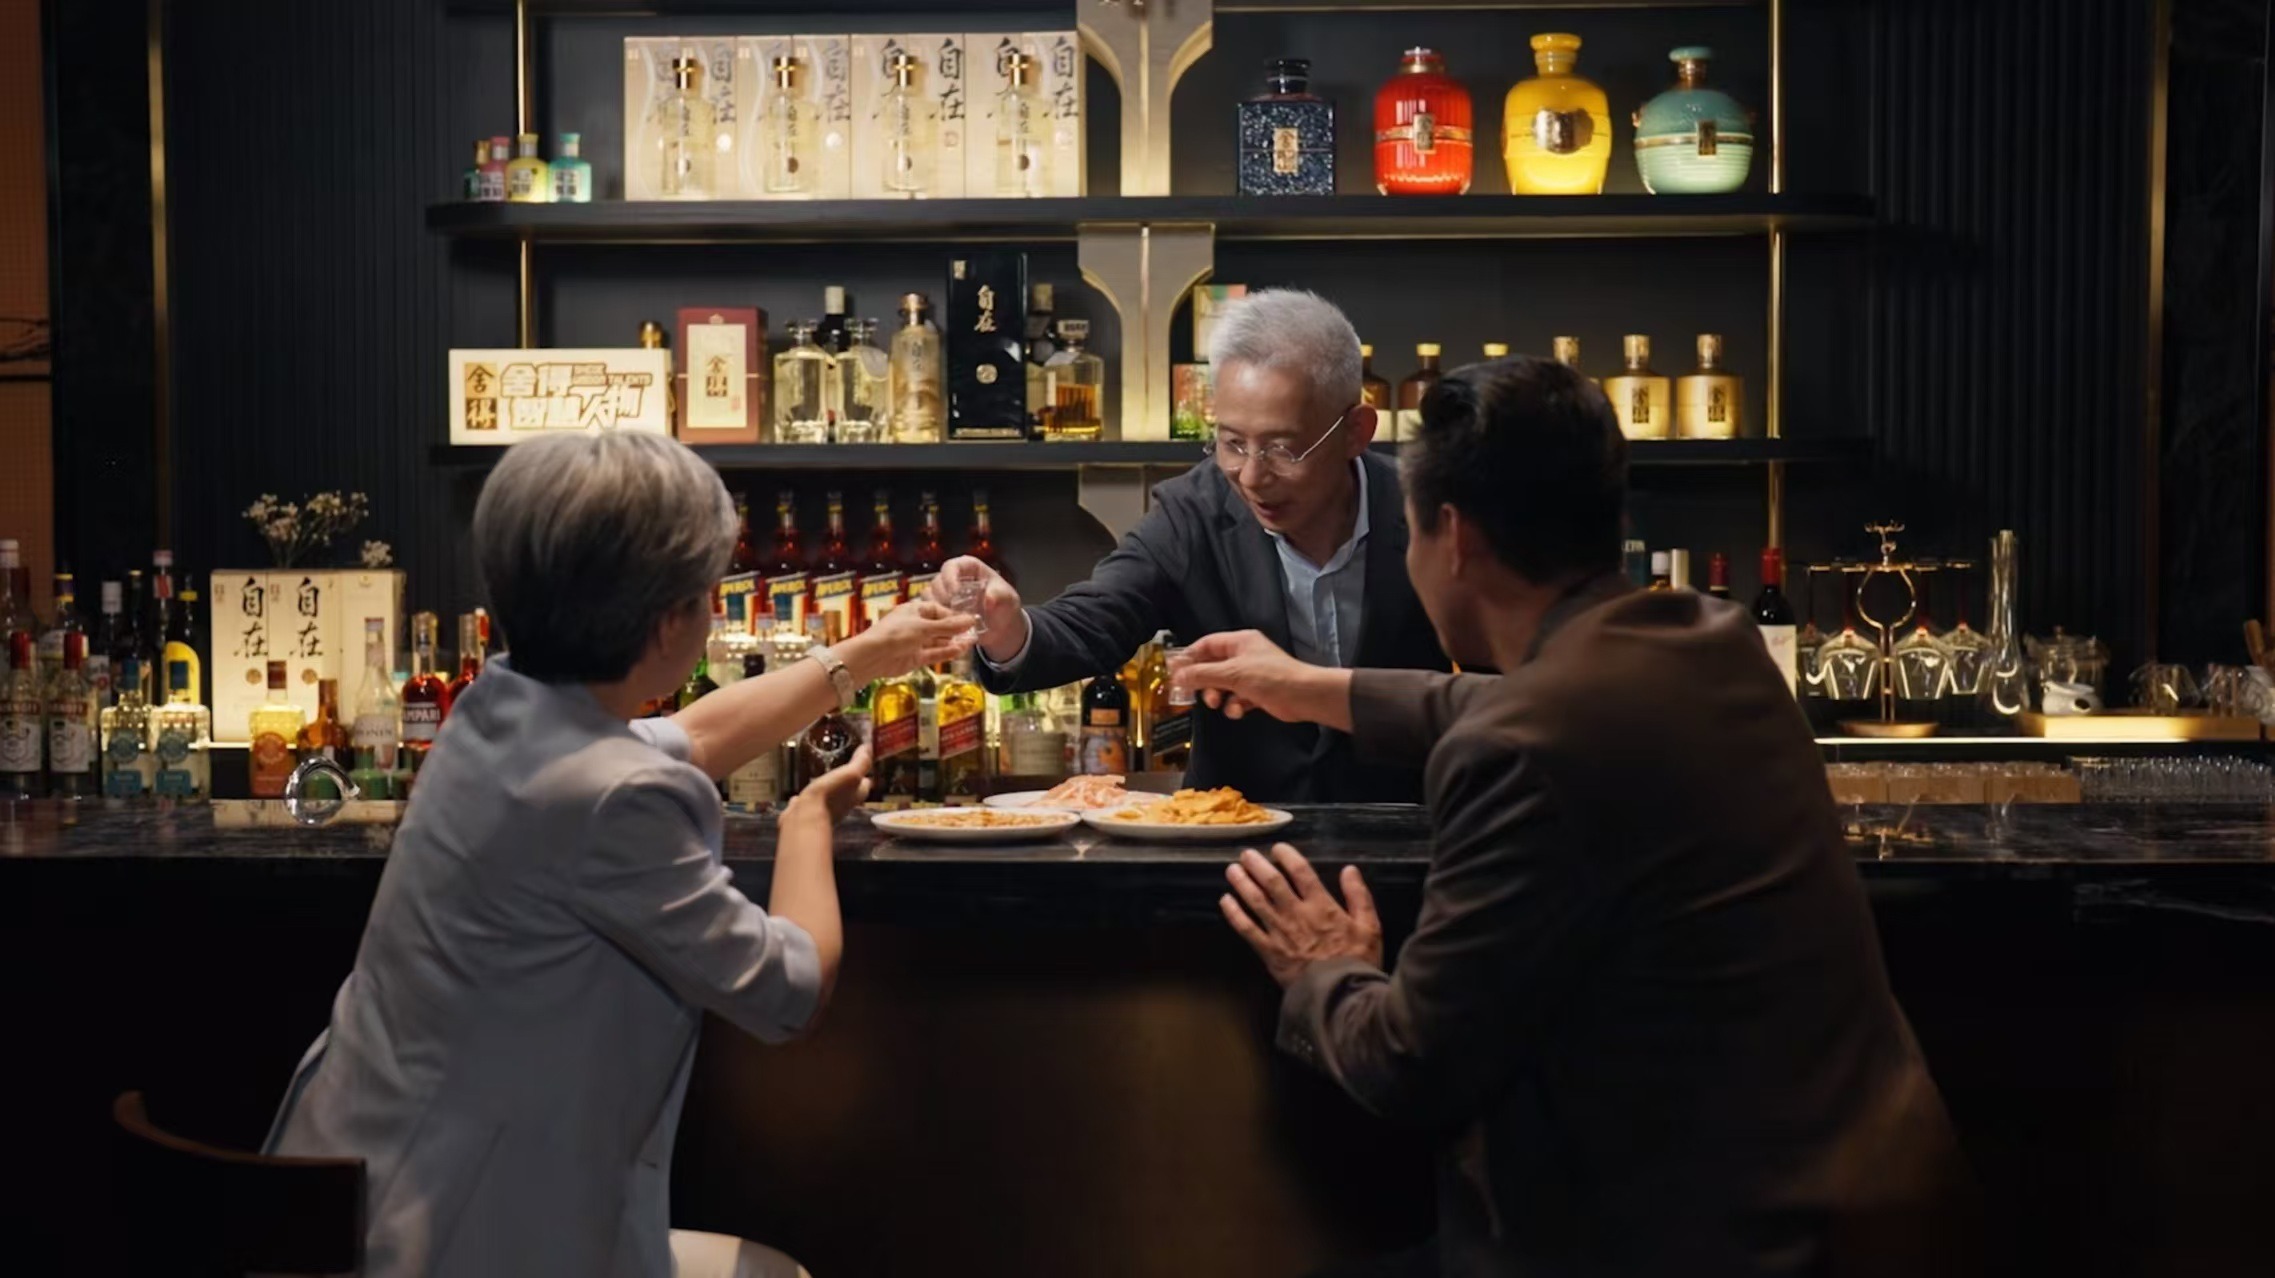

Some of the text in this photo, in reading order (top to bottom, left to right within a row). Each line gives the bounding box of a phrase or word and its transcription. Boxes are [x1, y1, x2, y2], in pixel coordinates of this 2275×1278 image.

[928, 37, 965, 121] 自在
[1043, 35, 1079, 120] 自在
[974, 284, 997, 333] 自在
[466, 363, 497, 429] 舍得
[234, 576, 268, 658] 自在
[289, 577, 324, 658] 自在
[403, 707, 441, 722] AMPARI
